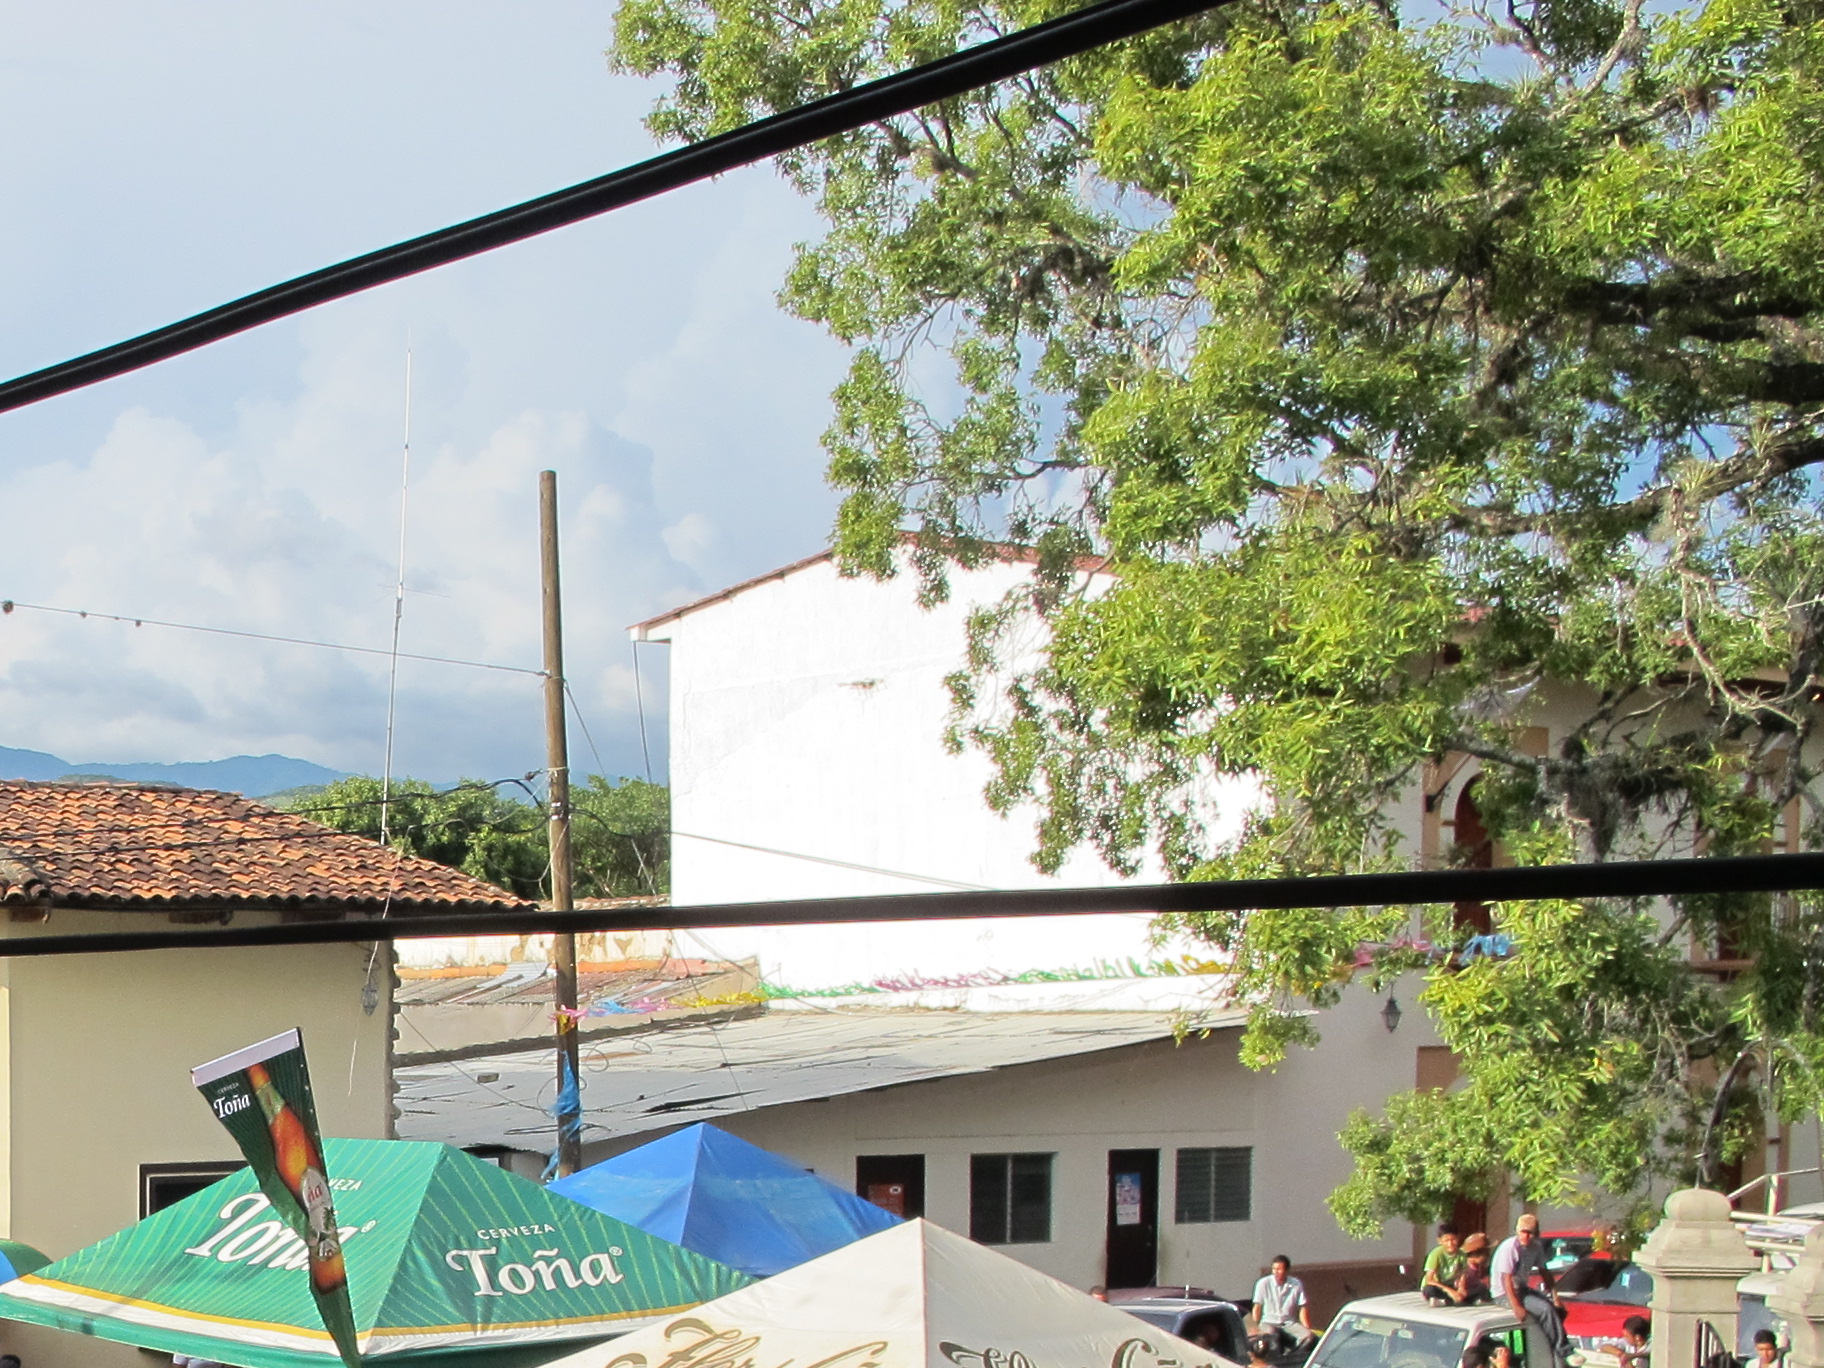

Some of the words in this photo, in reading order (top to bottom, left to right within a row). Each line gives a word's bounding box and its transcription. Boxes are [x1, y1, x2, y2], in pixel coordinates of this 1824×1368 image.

[213, 1093, 252, 1120] Toña
[328, 1177, 364, 1192] VEZA
[477, 1223, 556, 1240] CERVEZA
[445, 1248, 625, 1297] Toña
